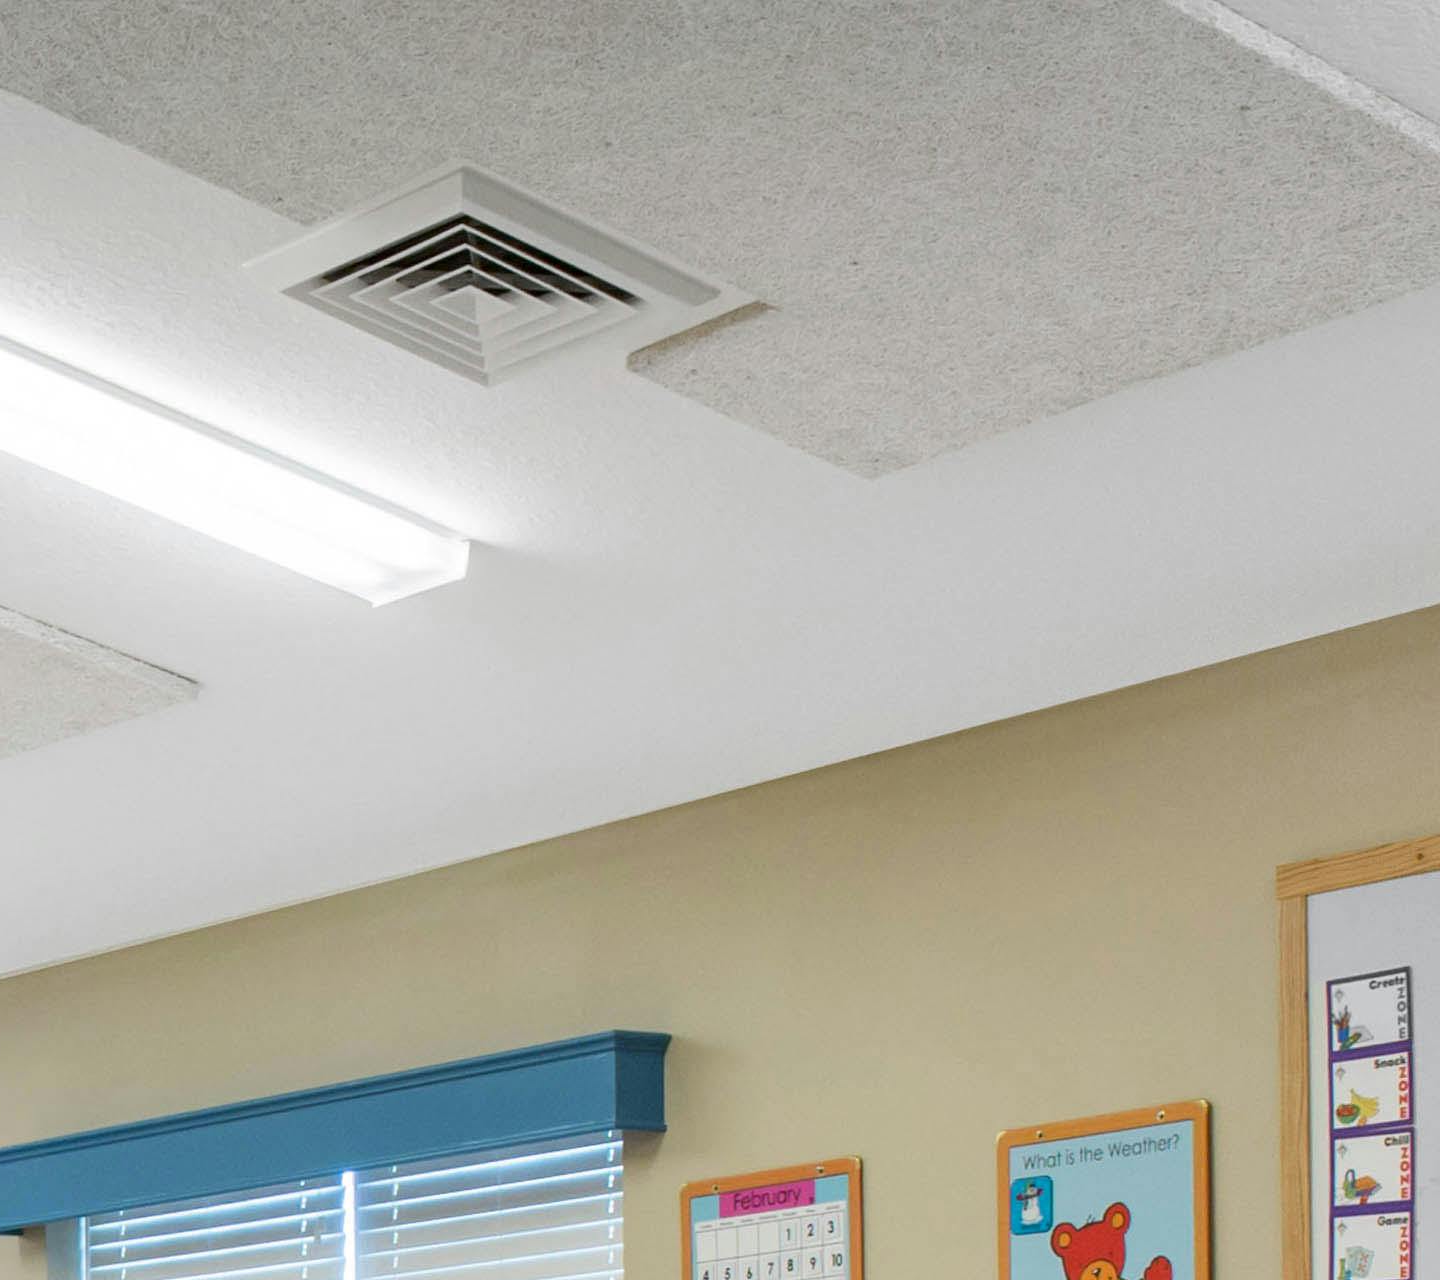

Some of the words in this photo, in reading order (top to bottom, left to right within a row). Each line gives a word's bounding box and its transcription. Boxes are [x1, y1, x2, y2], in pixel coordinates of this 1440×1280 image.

[1369, 976, 1405, 990] Create
[1397, 987, 1406, 1039] ZONE
[1374, 1055, 1406, 1069] Snack
[1399, 1066, 1408, 1118] ZONE
[1023, 1152, 1061, 1170] What
[1065, 1148, 1075, 1165] is
[1079, 1145, 1104, 1163] the
[1107, 1134, 1180, 1159] Weather?
[1384, 1135, 1409, 1146] Chill
[1401, 1147, 1409, 1199] ZONE
[733, 1186, 802, 1211] February
[786, 1228, 791, 1240] 1
[807, 1224, 814, 1236] 2
[827, 1221, 835, 1233] 3
[1377, 1216, 1409, 1226] Game
[1400, 1226, 1408, 1278] ZONE
[702, 1271, 710, 1280] 4
[724, 1268, 731, 1280] 5
[746, 1268, 753, 1279] 6
[767, 1262, 775, 1274] 7
[787, 1259, 794, 1271] 8
[809, 1257, 817, 1269] 9
[831, 1254, 843, 1266] 10
